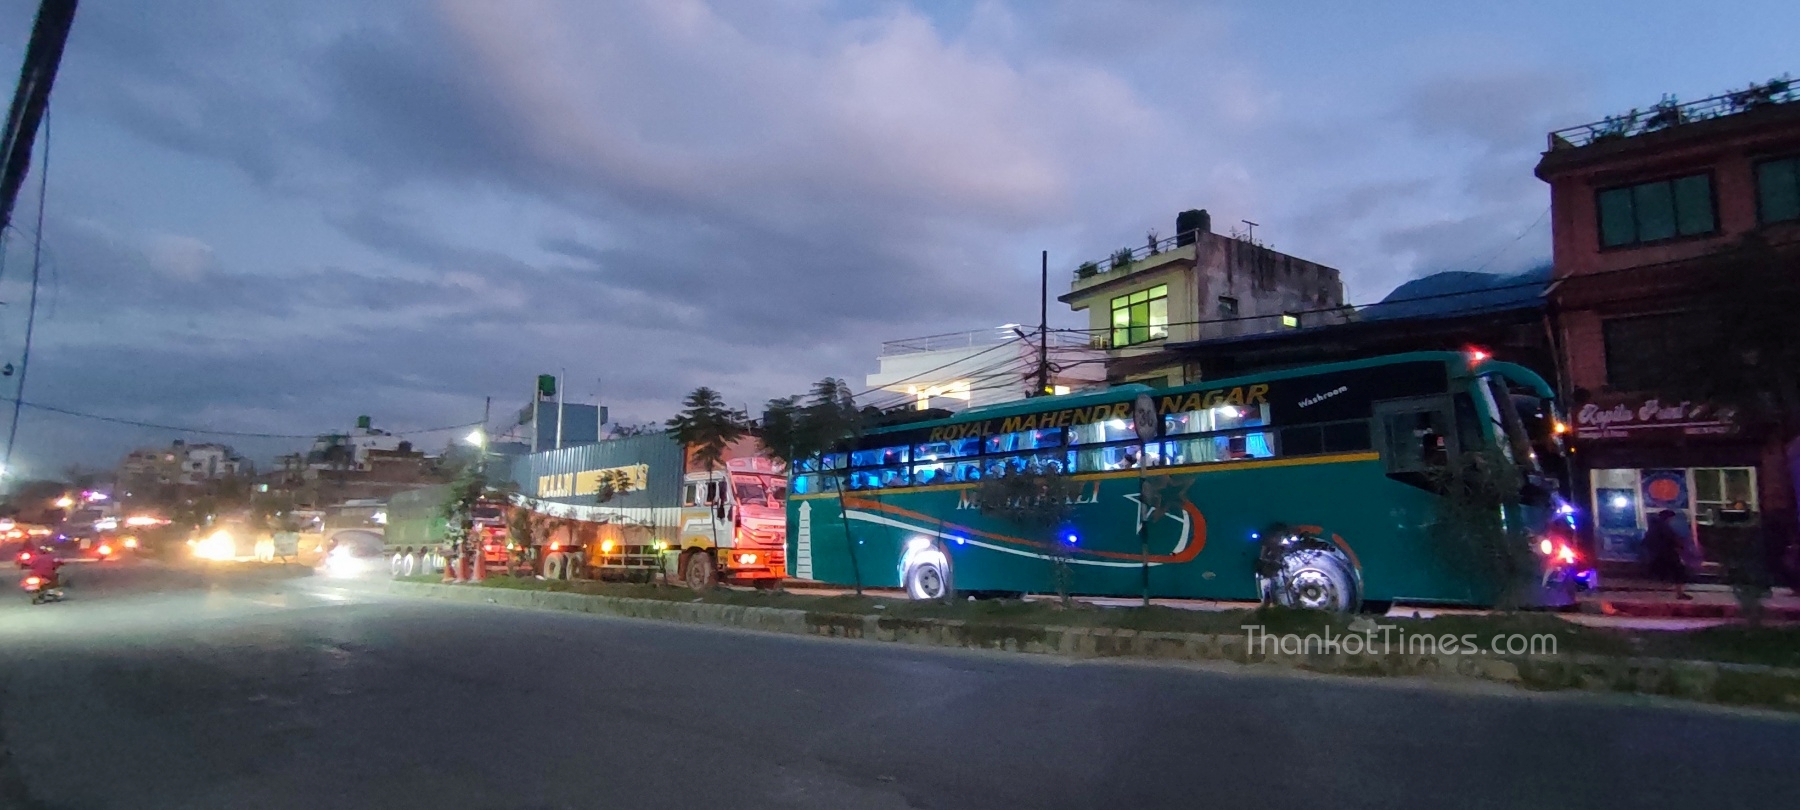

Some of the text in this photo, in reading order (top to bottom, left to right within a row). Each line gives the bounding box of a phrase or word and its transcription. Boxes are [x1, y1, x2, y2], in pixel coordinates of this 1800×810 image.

[929, 383, 1269, 442] ROYAL MAHENDR NAGAR
[1298, 385, 1348, 408] Washroom
